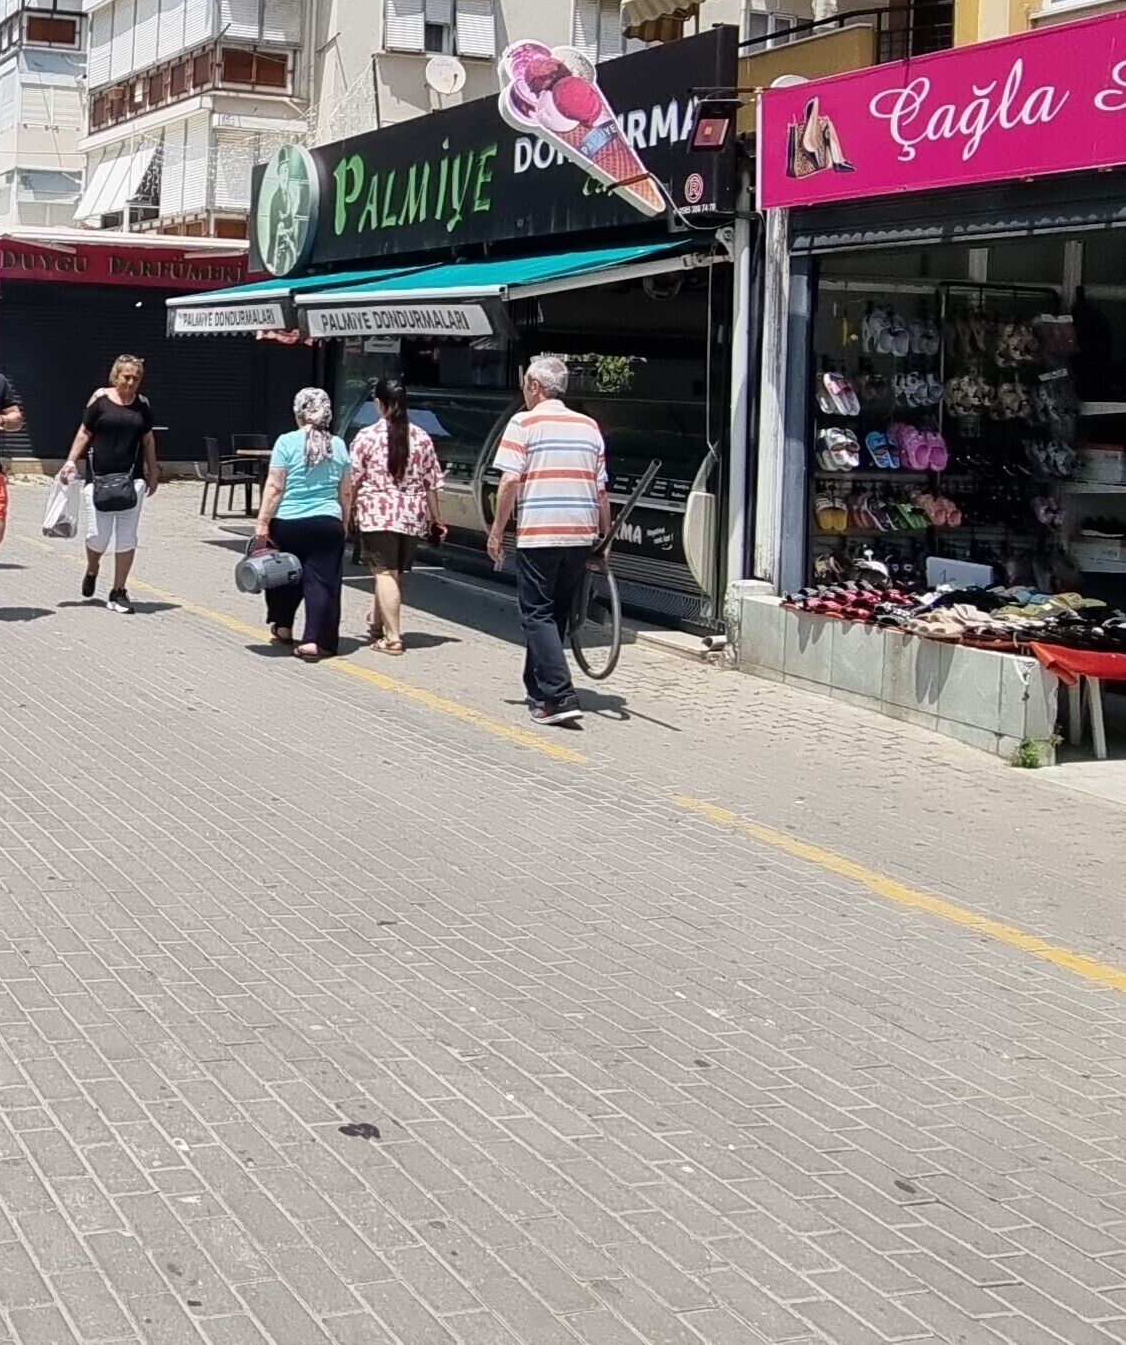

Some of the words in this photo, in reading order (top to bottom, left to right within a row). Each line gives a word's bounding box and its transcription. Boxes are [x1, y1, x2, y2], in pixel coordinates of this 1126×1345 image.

[870, 58, 1070, 161] Çağla
[333, 136, 498, 236] PALMİYE
[0, 249, 88, 274] DUYGU
[321, 310, 372, 331] PALMİYE
[373, 309, 471, 330] DONDURMALARI
